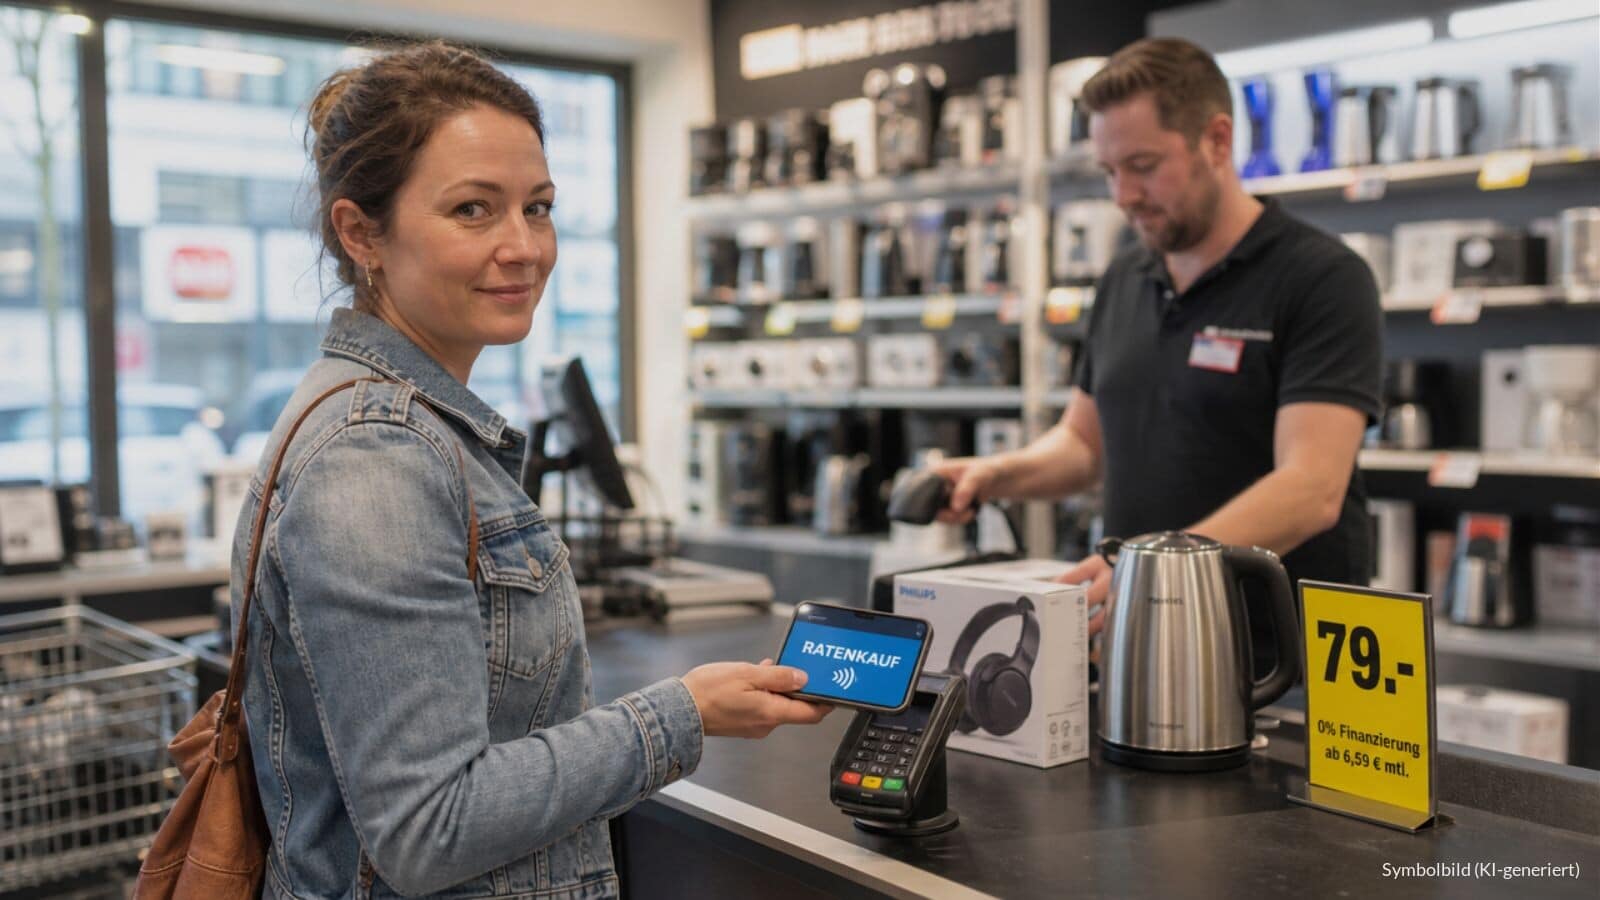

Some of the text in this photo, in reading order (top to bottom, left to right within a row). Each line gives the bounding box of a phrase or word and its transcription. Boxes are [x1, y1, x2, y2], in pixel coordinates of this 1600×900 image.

[801, 640, 902, 669] RATENKAUF
[1317, 619, 1414, 695] 79.-
[1317, 719, 1420, 759] 0% Finanzierung
[1325, 746, 1409, 778] ab 6,59 € mtl.
